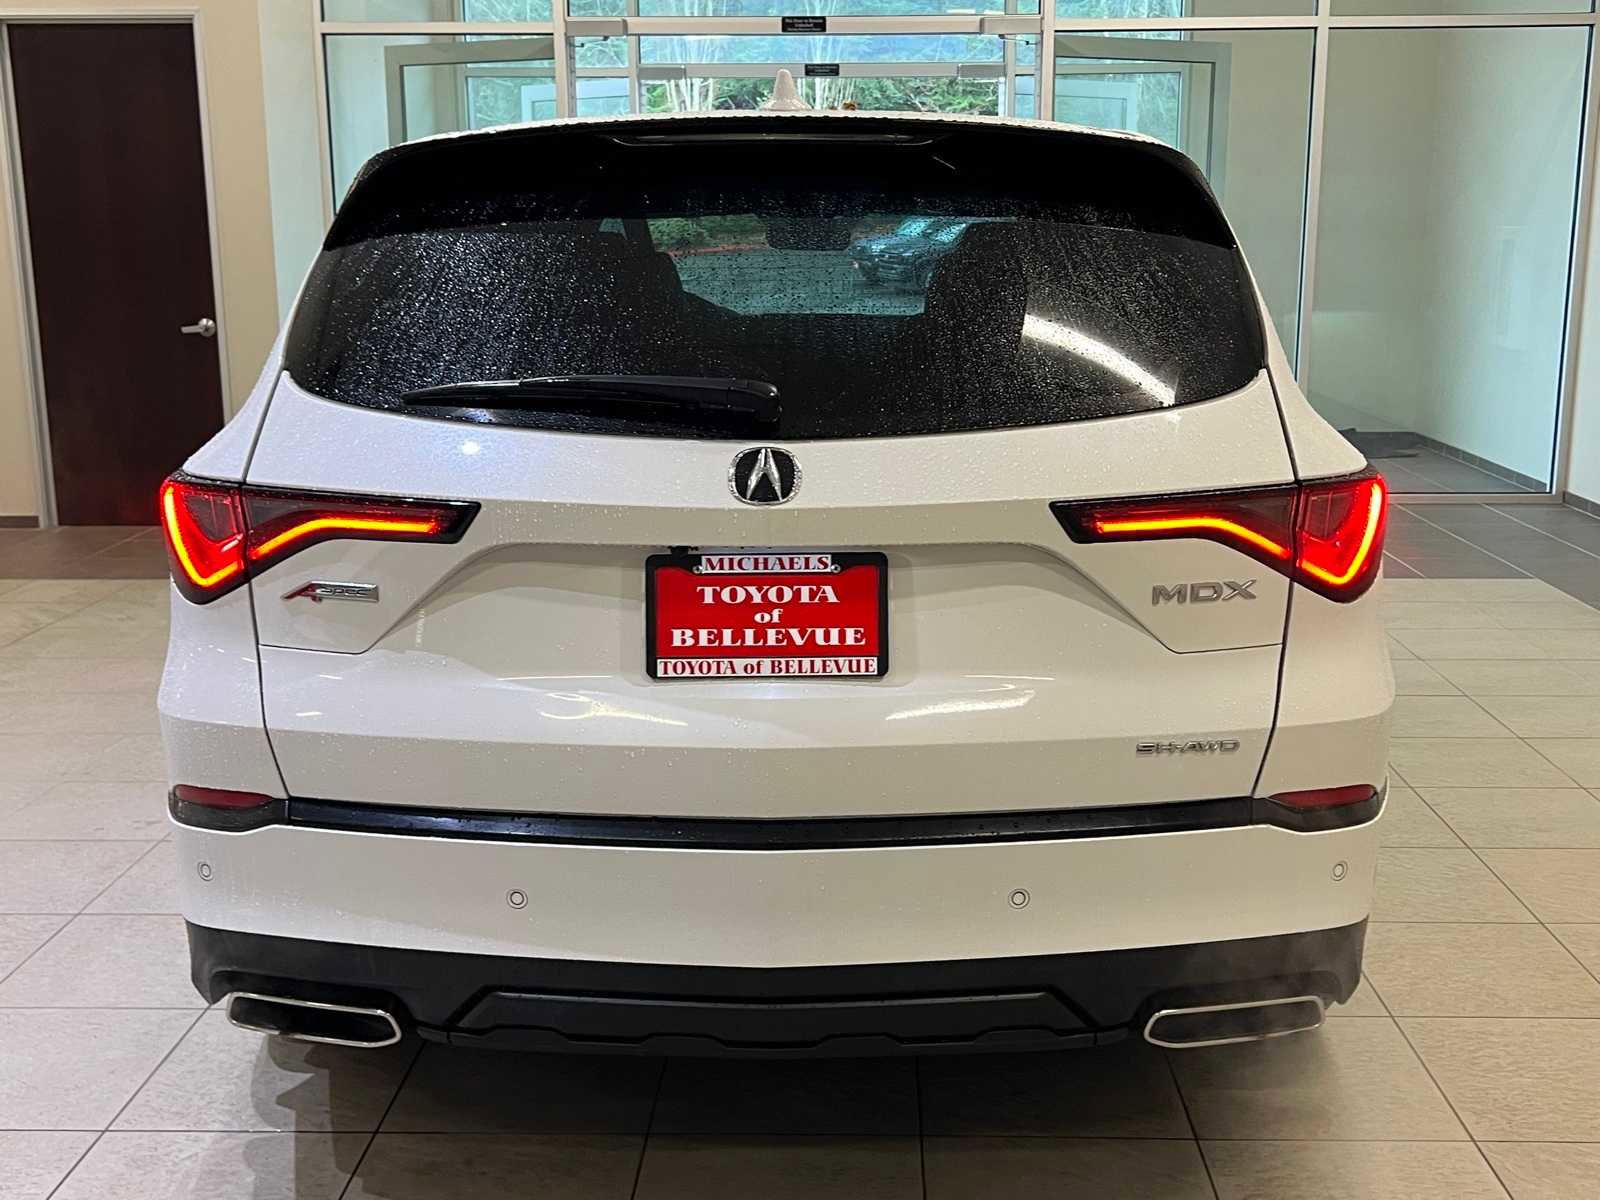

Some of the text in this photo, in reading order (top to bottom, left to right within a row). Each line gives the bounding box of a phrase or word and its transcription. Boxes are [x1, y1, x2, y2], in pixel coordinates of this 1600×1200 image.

[704, 555, 831, 572] MICHAELS
[696, 585, 840, 604] TOYOTA
[1151, 579, 1257, 606] MDX
[753, 608, 783, 624] of
[670, 627, 867, 647] BELLEVUE
[658, 658, 877, 676] TOYOTA of BELLEVUE
[1136, 739, 1241, 754] SH-AWD
